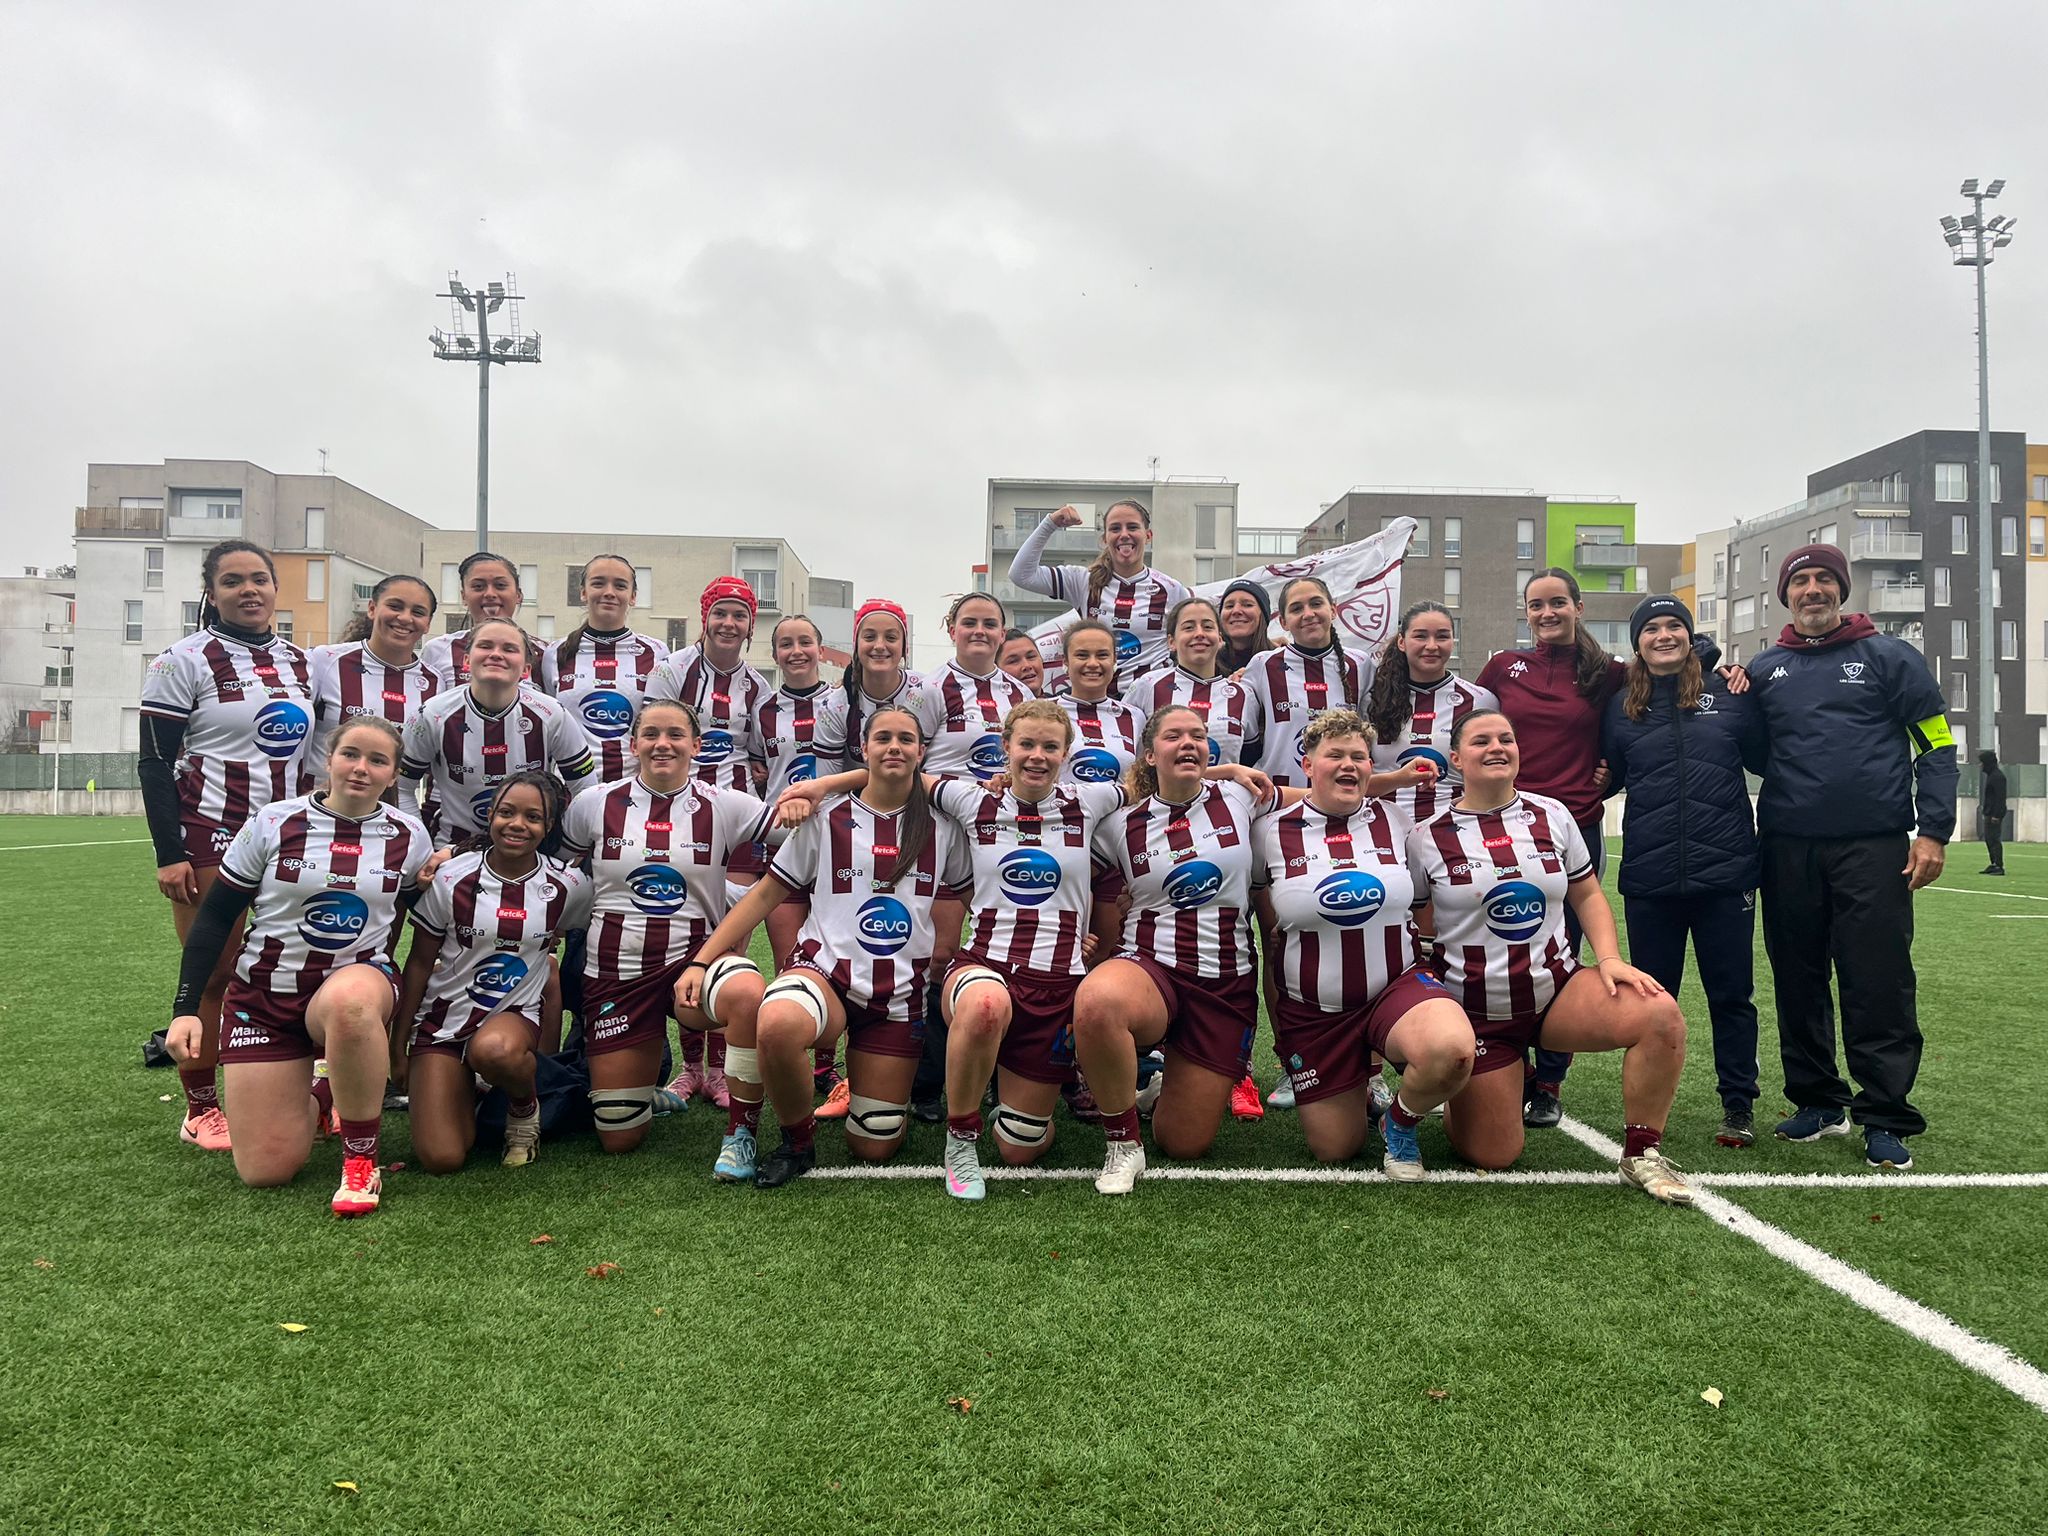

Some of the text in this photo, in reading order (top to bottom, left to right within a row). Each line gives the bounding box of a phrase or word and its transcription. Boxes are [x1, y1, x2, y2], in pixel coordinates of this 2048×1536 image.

[223, 680, 253, 691] epsa
[345, 705, 375, 716] epsa
[1276, 701, 1300, 713] epsa
[484, 746, 506, 754] Betclic
[331, 844, 361, 854] Betclic
[607, 837, 634, 849] epsa
[873, 846, 898, 855] Betclic
[1133, 849, 1159, 864] epsa
[283, 857, 316, 870] epsa
[1290, 853, 1319, 868] epsa
[1453, 861, 1482, 875] epsa
[837, 868, 863, 881] epsa
[498, 910, 525, 919] Betclic
[594, 1014, 628, 1030] Mano
[595, 1023, 629, 1040] Mano
[228, 1036, 270, 1048] Mano
[1292, 1068, 1317, 1083] Mano
[1294, 1077, 1320, 1093] Mano
